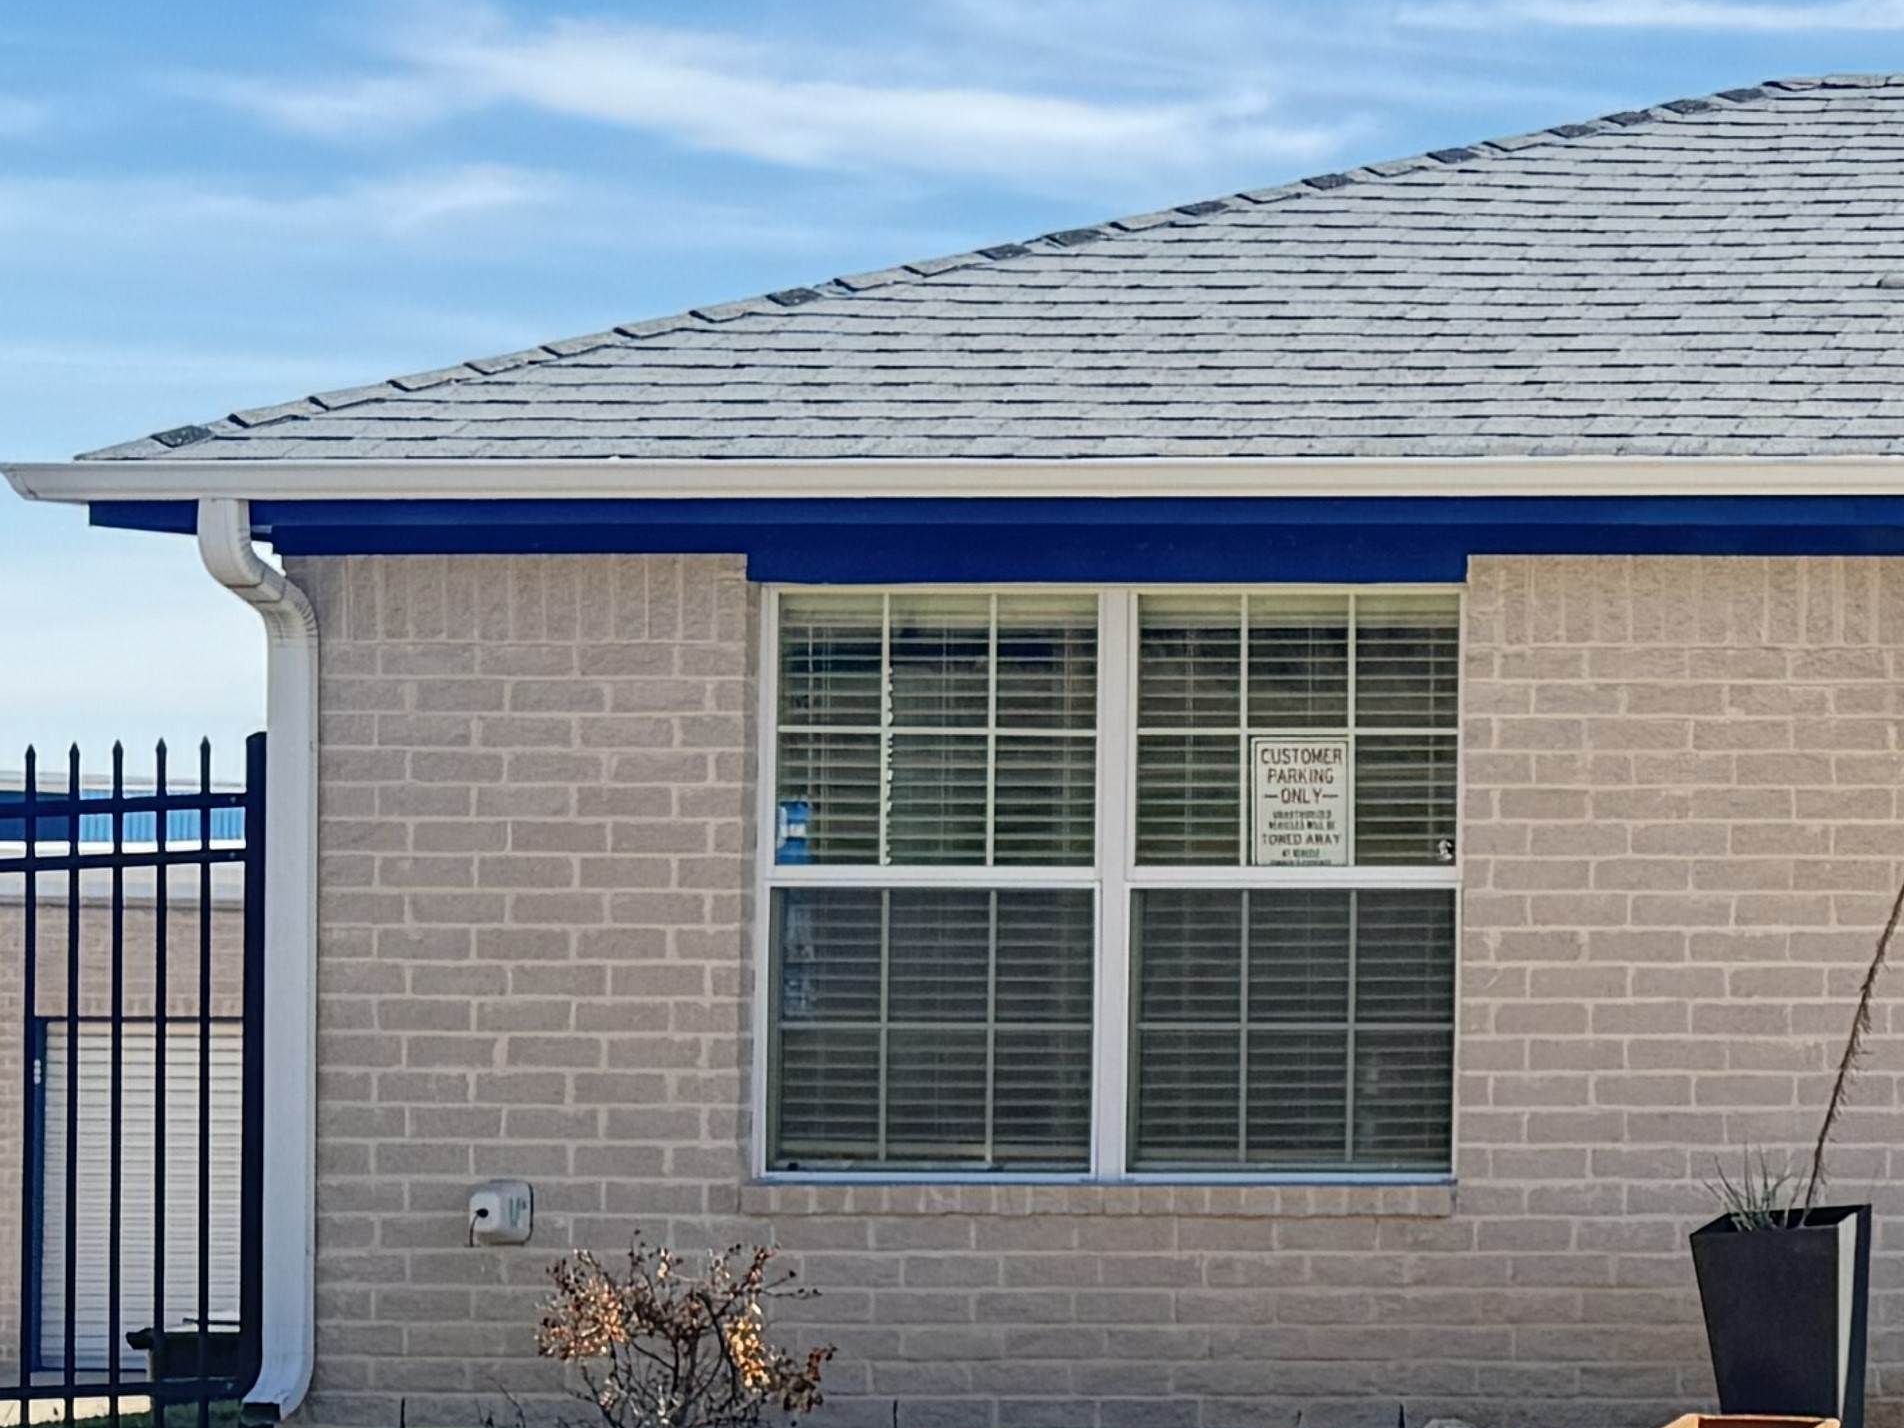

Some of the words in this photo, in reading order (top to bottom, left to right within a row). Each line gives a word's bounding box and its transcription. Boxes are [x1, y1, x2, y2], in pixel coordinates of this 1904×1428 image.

[1260, 747, 1342, 765] CUSTOMER
[1267, 768, 1334, 784] PARKING
[1281, 787, 1322, 804] ONLY
[1262, 833, 1302, 845] TOWED
[1305, 833, 1340, 845] AWAY
